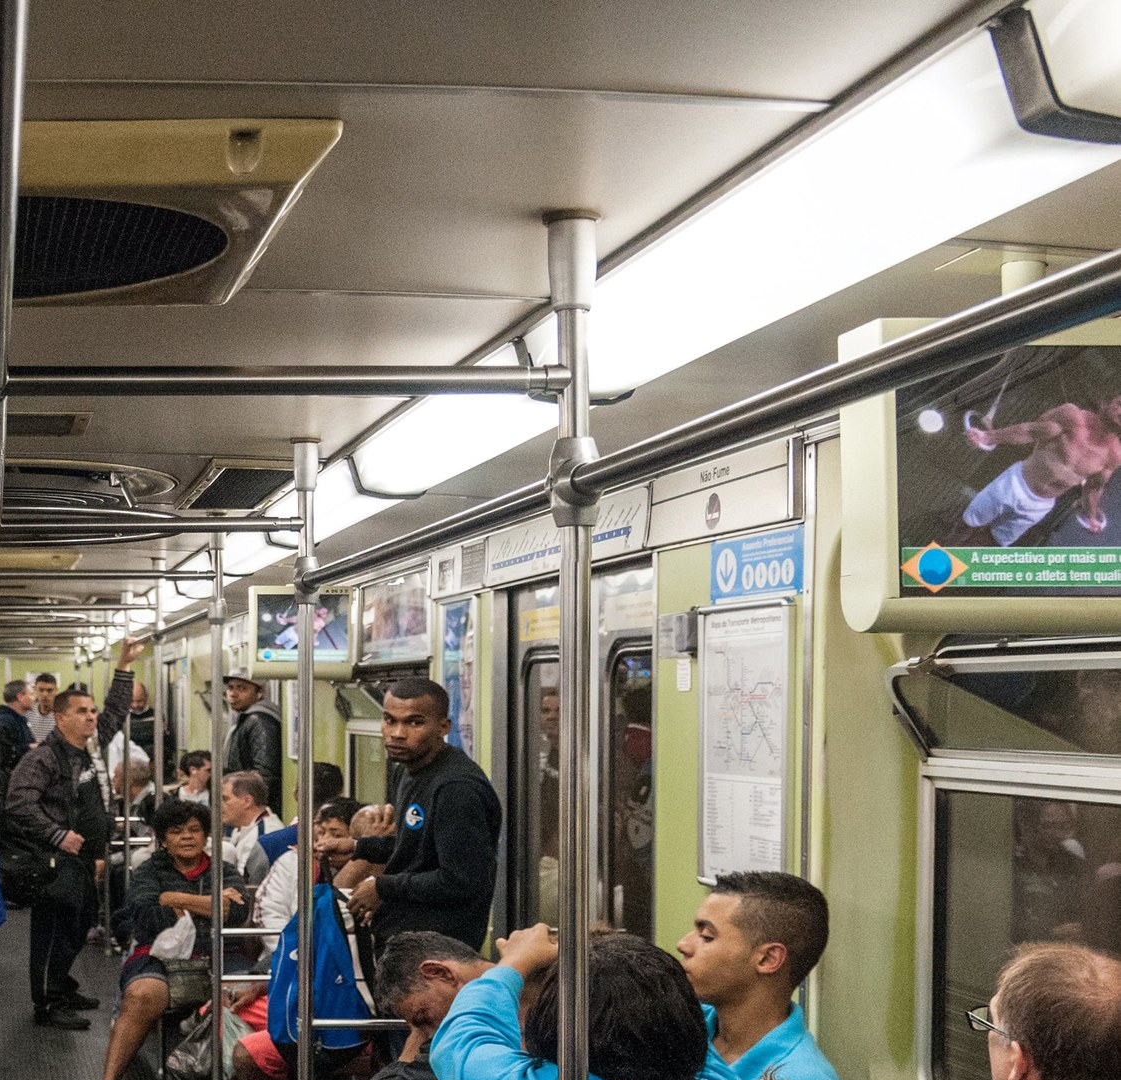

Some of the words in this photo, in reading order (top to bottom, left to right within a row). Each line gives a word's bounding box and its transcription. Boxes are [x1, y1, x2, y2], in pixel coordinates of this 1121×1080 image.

[700, 470, 712, 483] Não
[712, 466, 730, 479] Fume
[971, 551, 979, 564] A
[981, 551, 1045, 567] expectativa
[1047, 552, 1067, 566] por
[1069, 551, 1096, 564] mais
[1098, 553, 1117, 564] um
[971, 571, 1013, 582] enorme
[1015, 571, 1023, 582] e
[1025, 571, 1033, 582] o
[1035, 569, 1067, 582] atleta
[1069, 570, 1091, 582] tem
